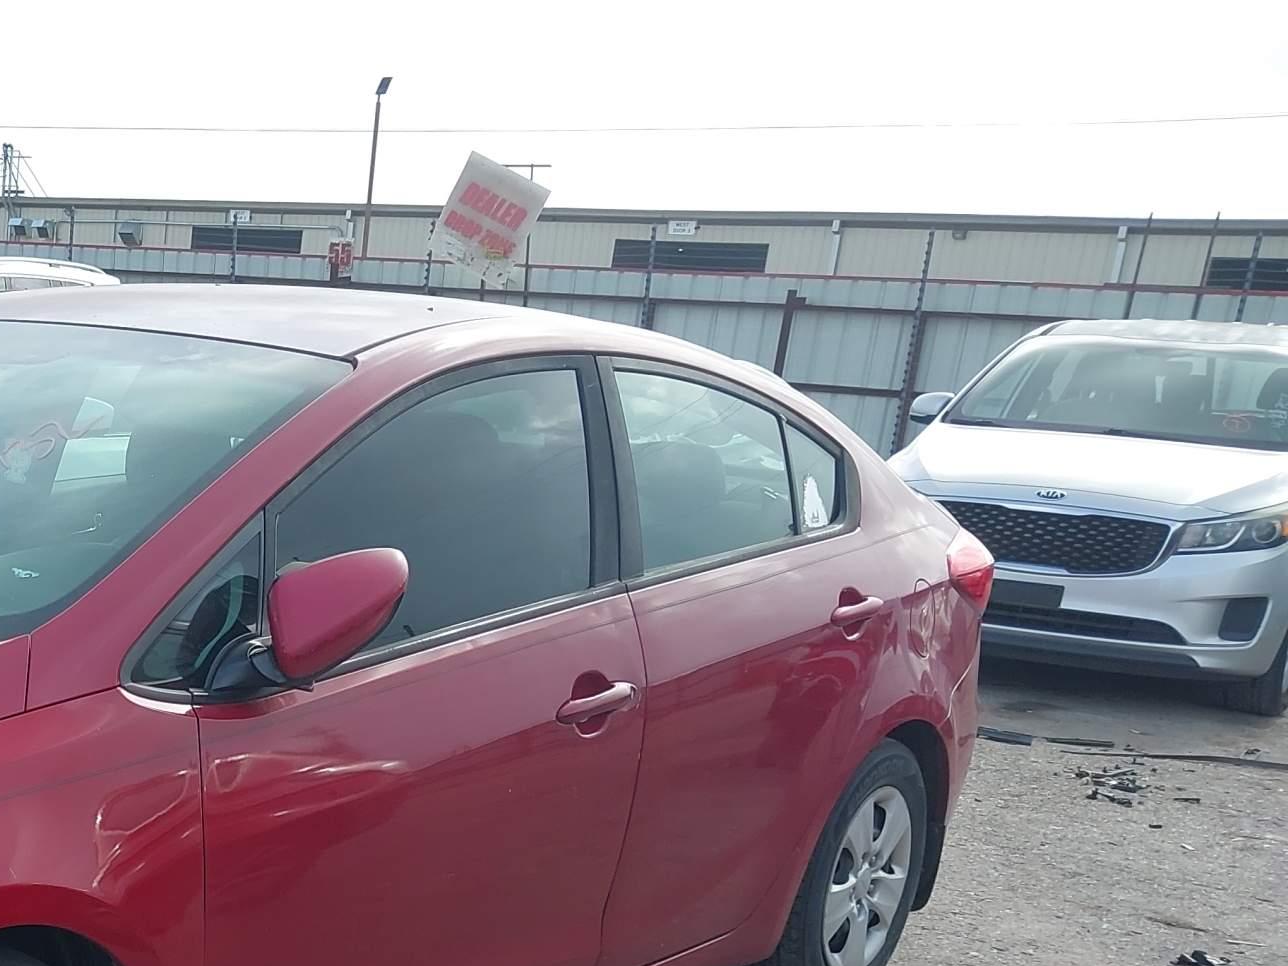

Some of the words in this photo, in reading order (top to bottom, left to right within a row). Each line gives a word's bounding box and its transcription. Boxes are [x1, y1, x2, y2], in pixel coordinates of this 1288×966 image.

[459, 181, 528, 232] DEALER
[328, 241, 352, 265] 55
[1038, 489, 1063, 498] KIA
